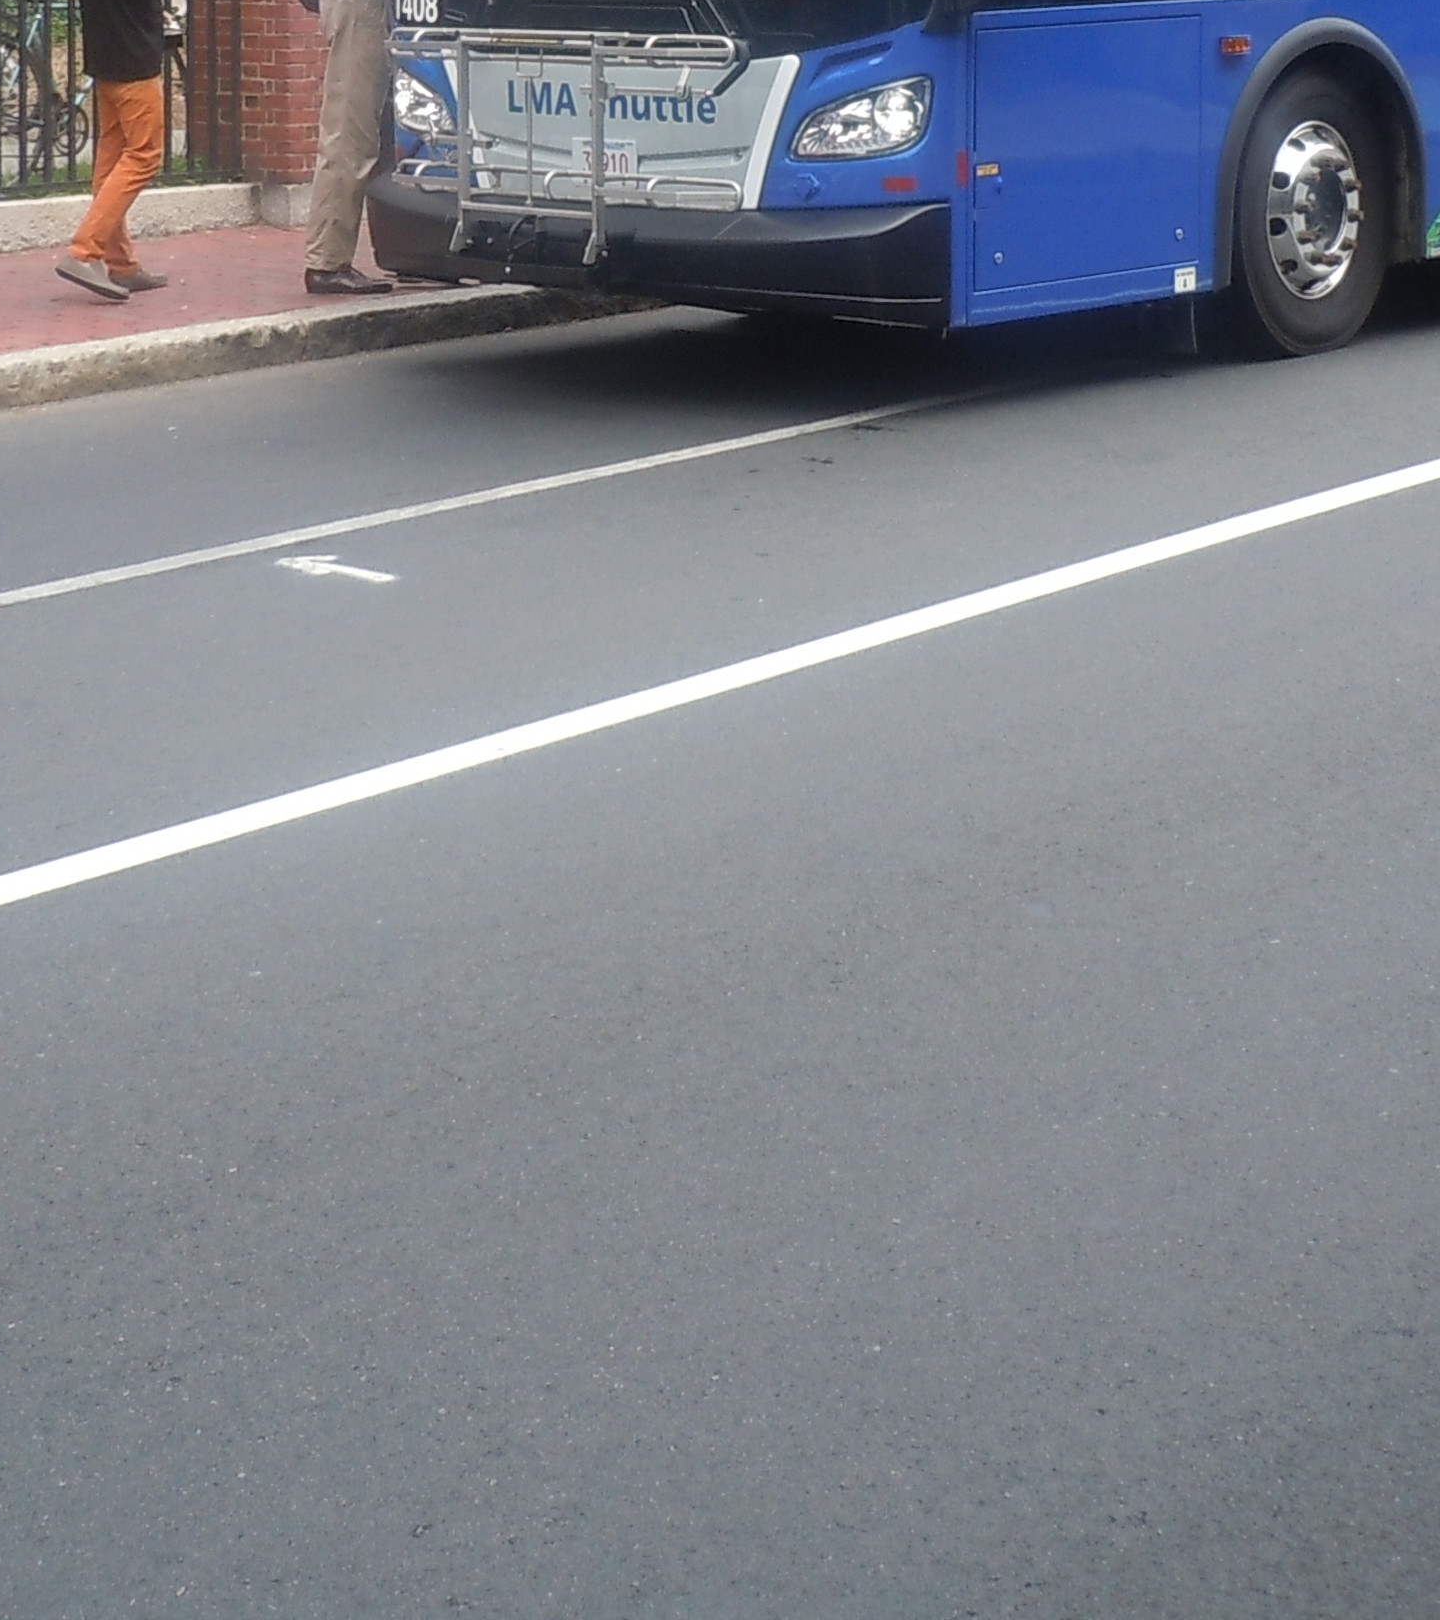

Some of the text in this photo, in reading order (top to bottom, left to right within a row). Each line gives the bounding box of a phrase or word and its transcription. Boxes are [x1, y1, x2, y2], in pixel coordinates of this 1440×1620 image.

[507, 79, 717, 124] LMA huttle
[582, 150, 629, 174] 3910
